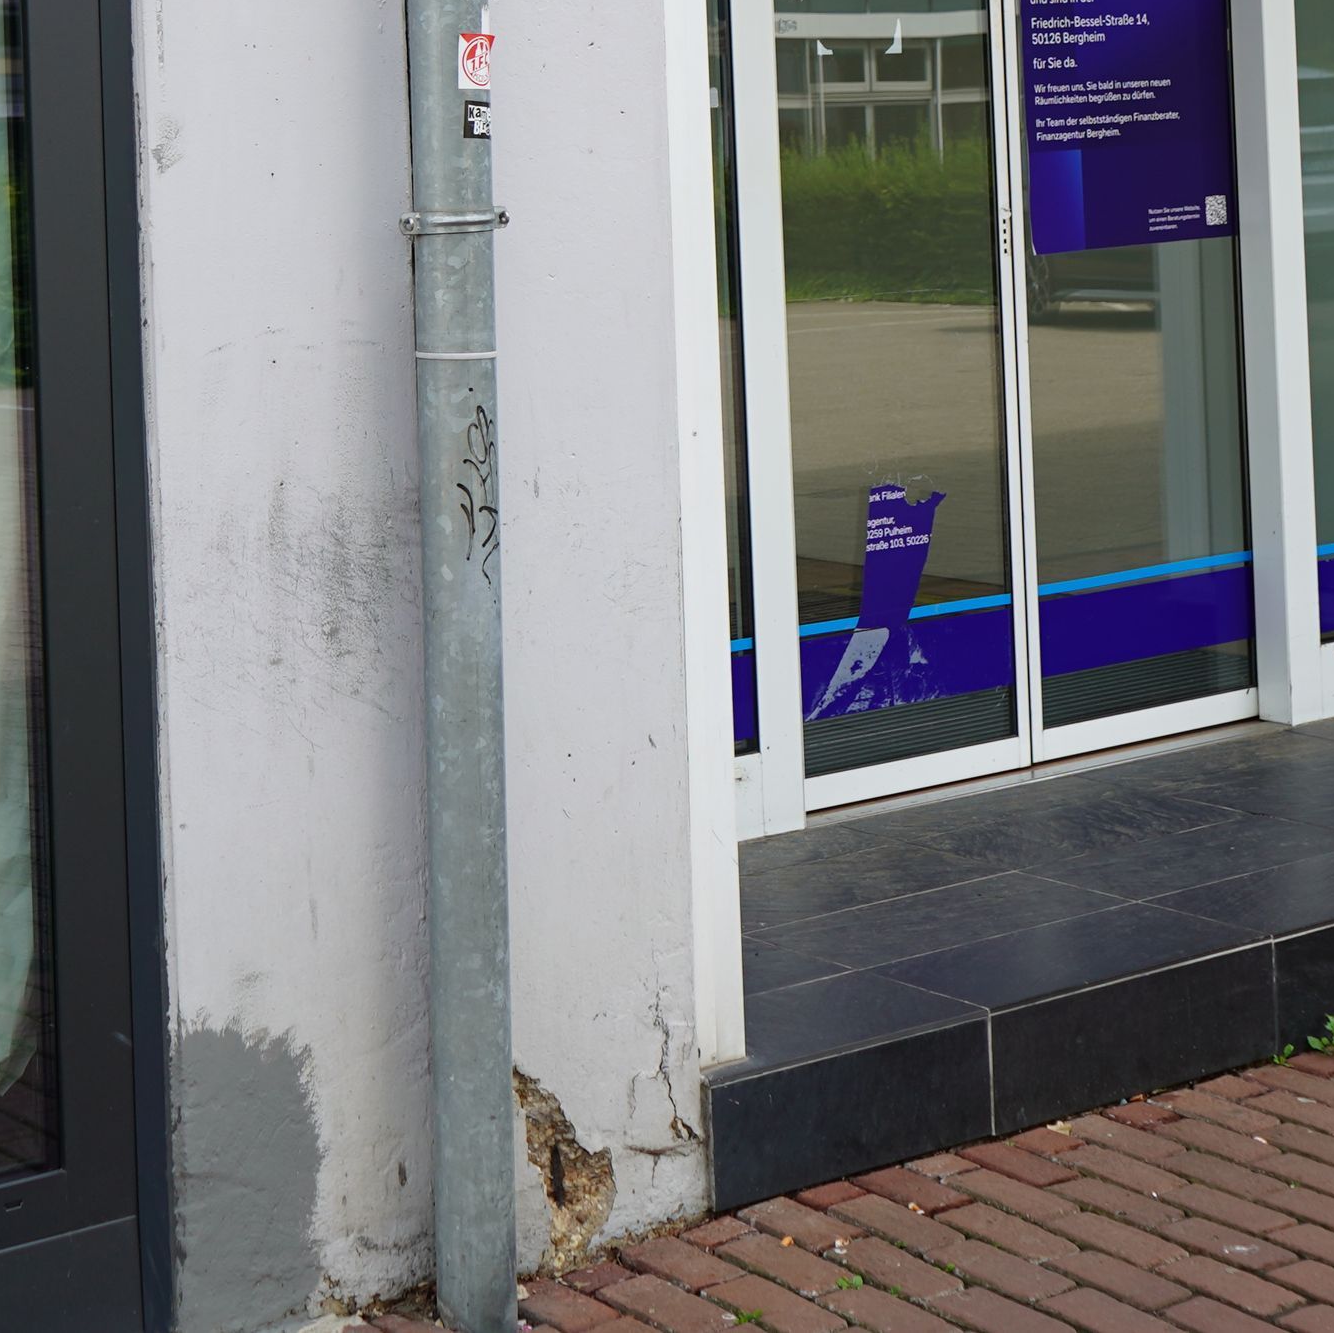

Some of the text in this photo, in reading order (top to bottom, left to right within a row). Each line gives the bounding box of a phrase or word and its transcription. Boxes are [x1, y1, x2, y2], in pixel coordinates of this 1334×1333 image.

[1031, 14, 1149, 28] Friedrich-Bessel-Straße 14,
[1032, 31, 1105, 45] 50126 Bergheim
[1034, 57, 1077, 69] für Sie da.
[1034, 84, 1046, 93] Wir
[1048, 82, 1070, 92] freuen
[1087, 81, 1097, 90] Sie
[1099, 80, 1113, 90] bald
[1115, 81, 1121, 89] in
[1123, 80, 1149, 88] unseren
[1150, 78, 1171, 87] neuen
[1035, 94, 1087, 106] Räumlichkeiten
[1089, 92, 1121, 104] begrüßen
[1132, 91, 1155, 100] dürfen.
[1036, 111, 1180, 128] Ihr Team der selbstständigen Finanzberater,
[1037, 128, 1120, 142] Finanzagentur Bergheim.
[882, 491, 906, 500] Filialen
[884, 526, 912, 537] Pulheim
[890, 538, 905, 548] 103,
[907, 534, 929, 546] 50226
